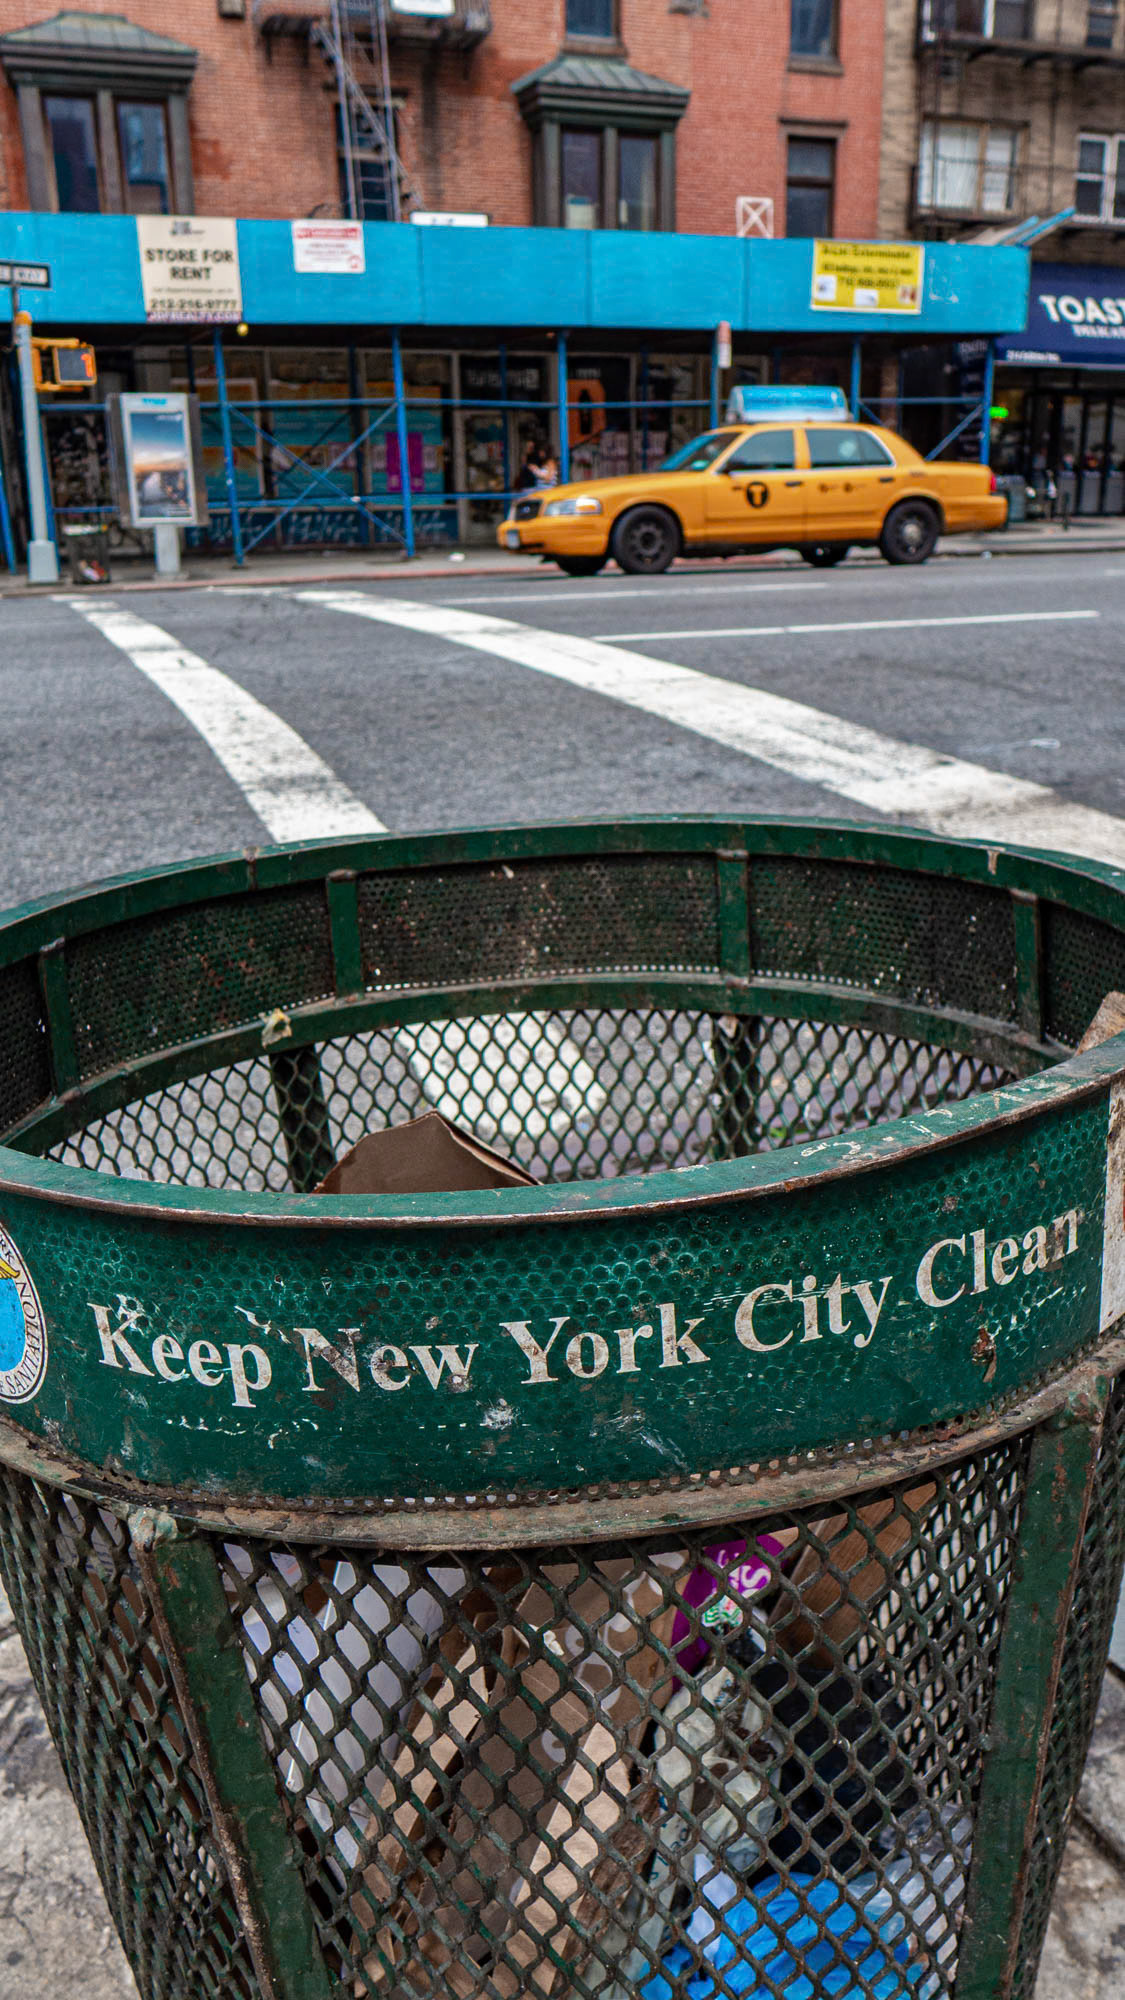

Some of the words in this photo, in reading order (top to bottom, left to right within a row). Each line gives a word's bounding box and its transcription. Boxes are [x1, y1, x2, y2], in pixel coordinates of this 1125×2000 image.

[145, 248, 197, 263] STORE
[202, 249, 234, 263] FOR
[169, 266, 213, 280] RENT
[6, 1282, 41, 1395] SANITATION
[87, 1302, 272, 1408] Keep
[293, 1327, 480, 1392] New
[499, 1303, 711, 1384] York
[734, 1271, 893, 1352] City
[915, 1207, 1082, 1309] Clean
